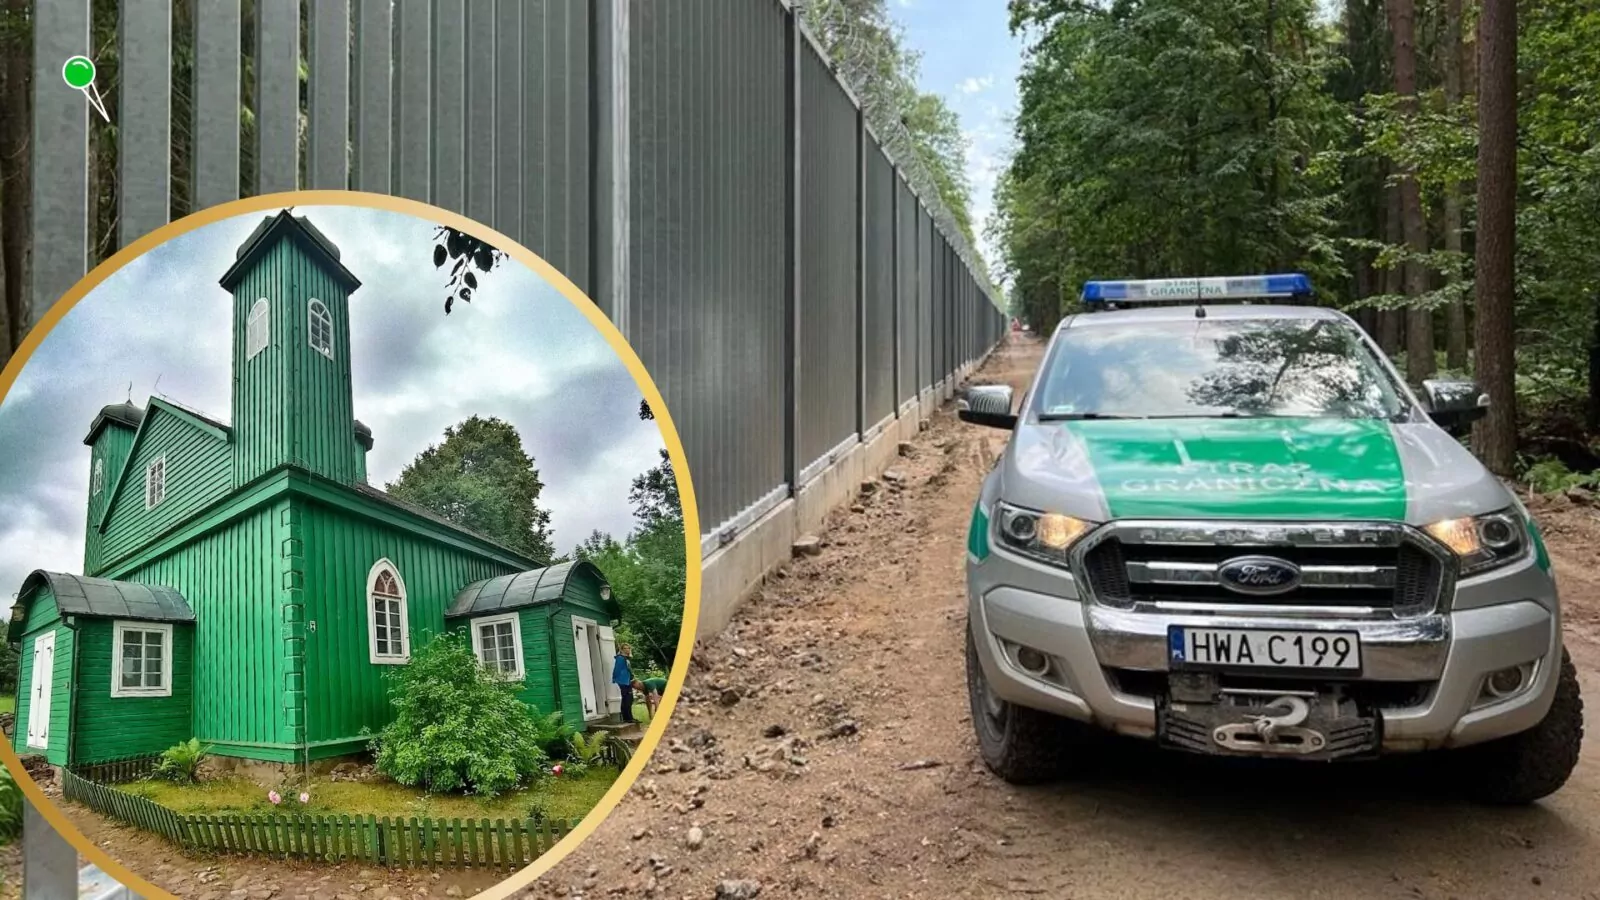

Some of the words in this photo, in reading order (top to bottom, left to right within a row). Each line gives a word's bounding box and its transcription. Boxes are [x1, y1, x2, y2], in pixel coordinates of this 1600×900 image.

[1150, 285, 1223, 296] GRANICZNA
[1120, 475, 1386, 493] GRANICZNA
[1238, 564, 1282, 585] Ford
[1191, 632, 1254, 664] HWA
[1267, 635, 1351, 667] C199
